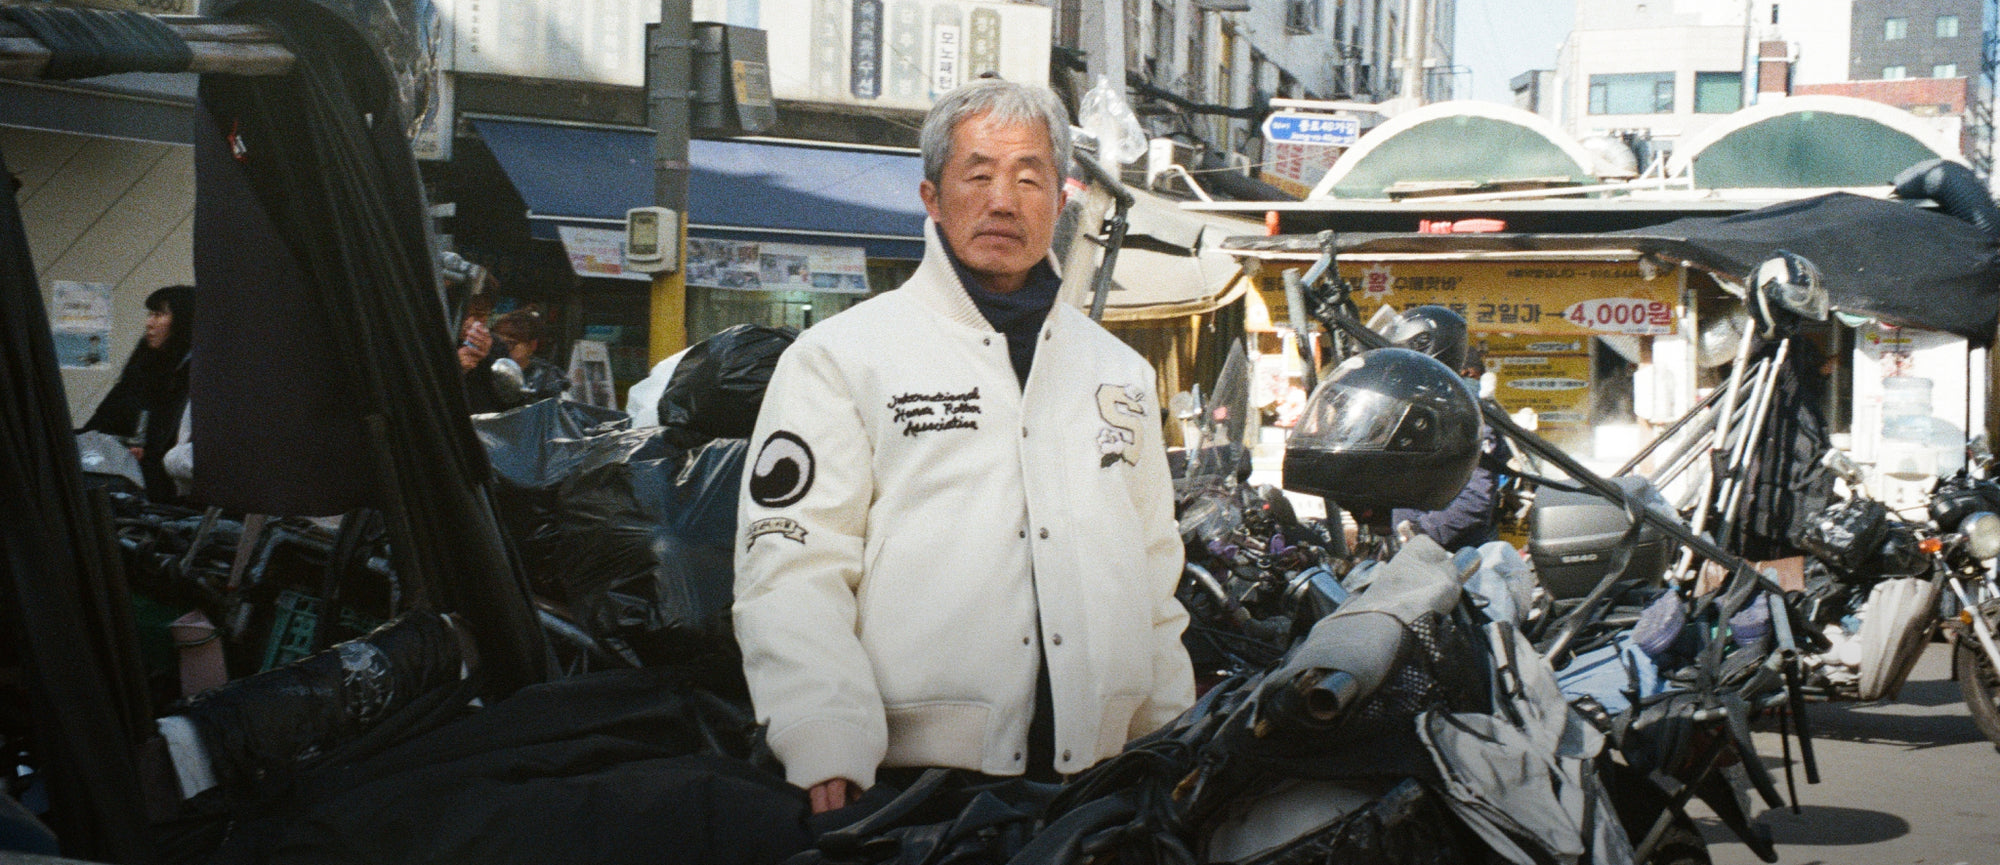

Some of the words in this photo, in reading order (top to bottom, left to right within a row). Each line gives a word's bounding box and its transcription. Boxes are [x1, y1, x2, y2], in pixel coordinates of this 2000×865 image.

[1477, 303, 1541, 323] 균일가
[1570, 302, 1672, 327] 4,000원
[903, 416, 978, 437] Association
